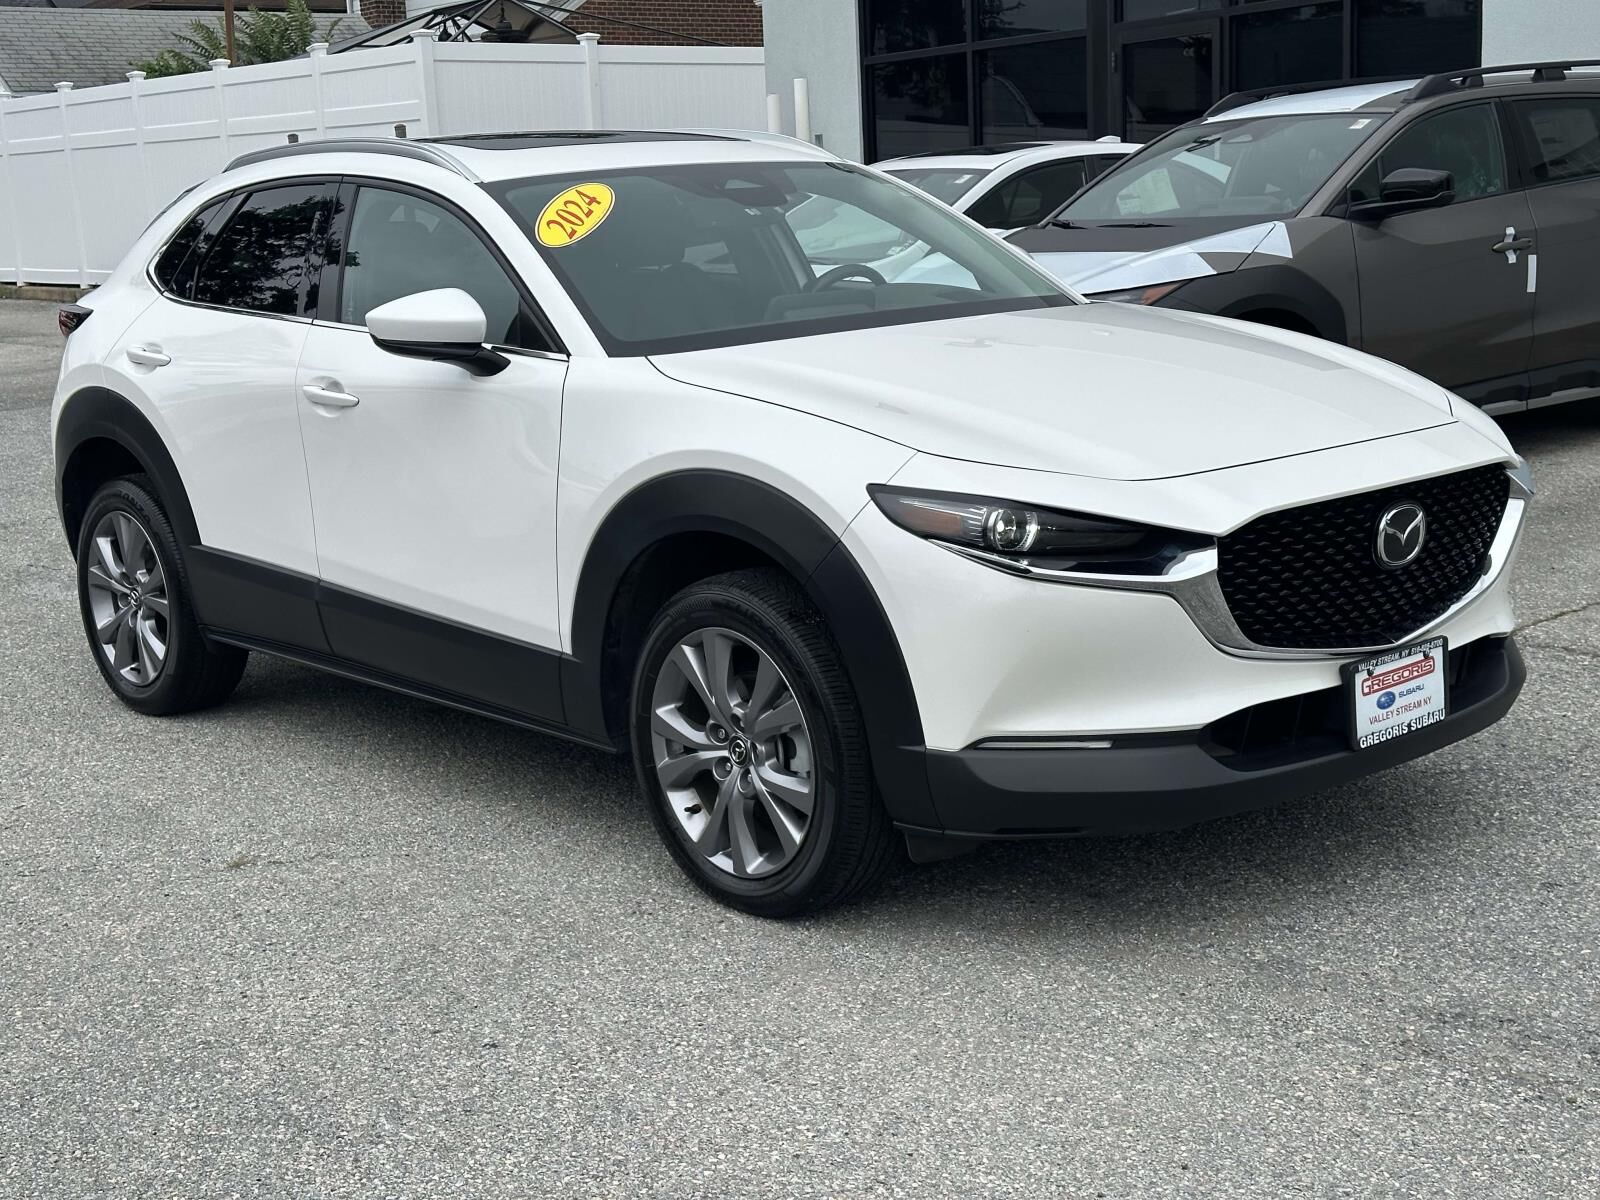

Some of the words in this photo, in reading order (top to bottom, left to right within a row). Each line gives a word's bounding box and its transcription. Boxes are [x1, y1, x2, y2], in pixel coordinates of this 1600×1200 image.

[546, 189, 602, 240] 2024
[1358, 659, 1378, 672] VALLEY
[1401, 649, 1410, 658] NY
[1362, 659, 1434, 696] GREGORIS
[1398, 683, 1425, 699] SUBARU
[1368, 708, 1395, 725] VALLEY
[1395, 699, 1423, 716] STREAM
[1423, 695, 1432, 706] NY
[1359, 722, 1409, 748] GREGORIS
[1410, 708, 1446, 731] SUBARU
